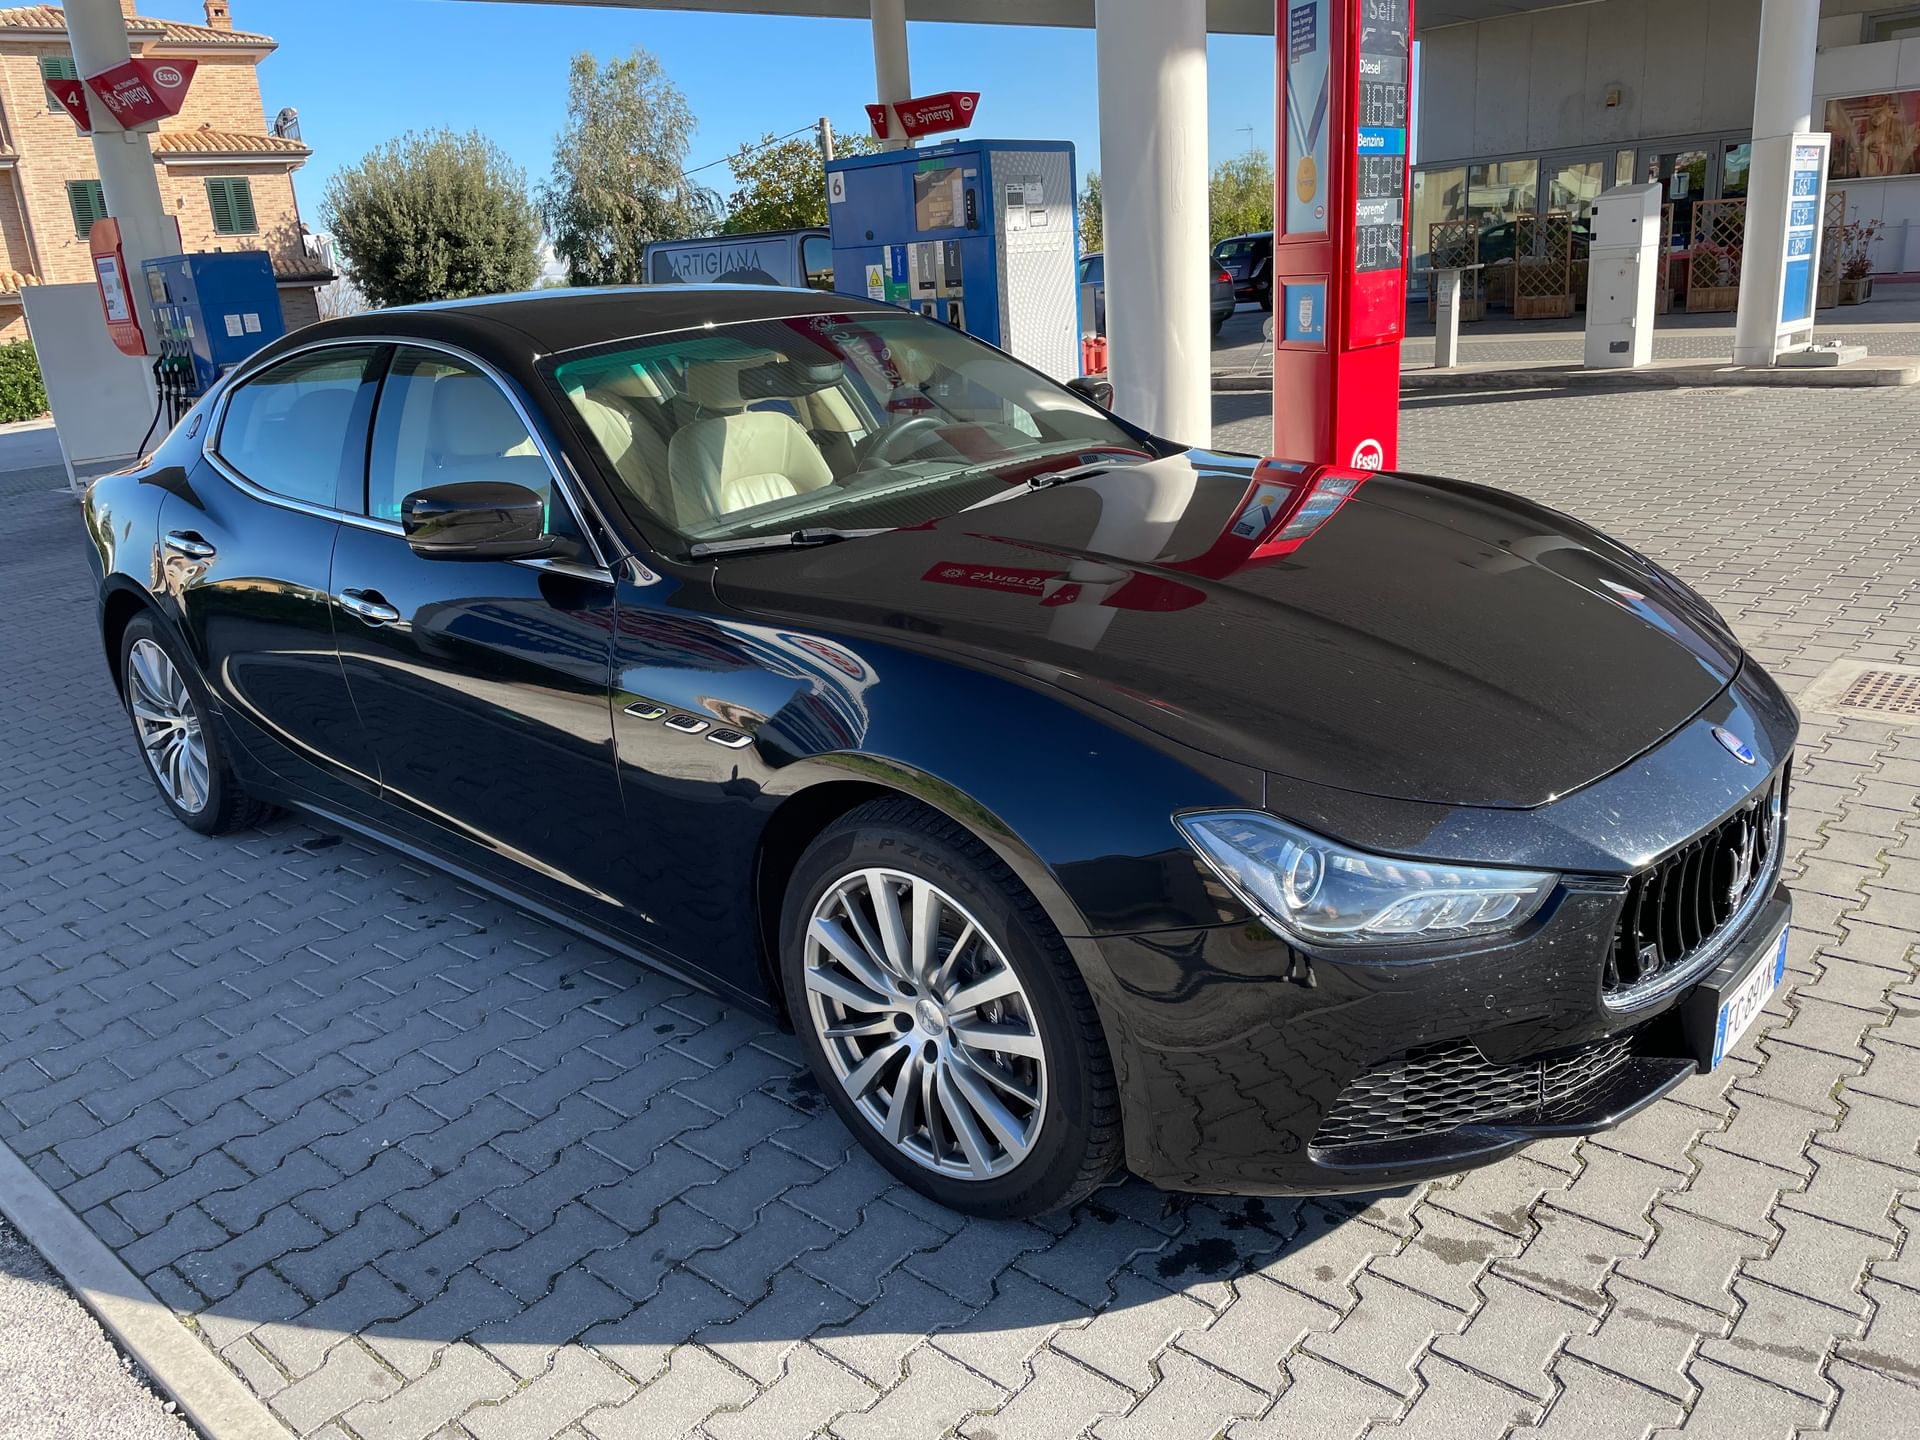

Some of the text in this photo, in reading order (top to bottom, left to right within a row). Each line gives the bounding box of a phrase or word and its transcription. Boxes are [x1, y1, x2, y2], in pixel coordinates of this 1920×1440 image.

[1360, 59, 1381, 75] Diesel
[157, 71, 179, 82] Esso
[67, 90, 80, 106] 4
[113, 84, 153, 110] Synergy
[878, 112, 885, 123] 2
[916, 108, 955, 125] Synergy
[1358, 133, 1385, 148] Benzina
[832, 178, 842, 197] 6
[671, 248, 762, 278] ARTIGIANA
